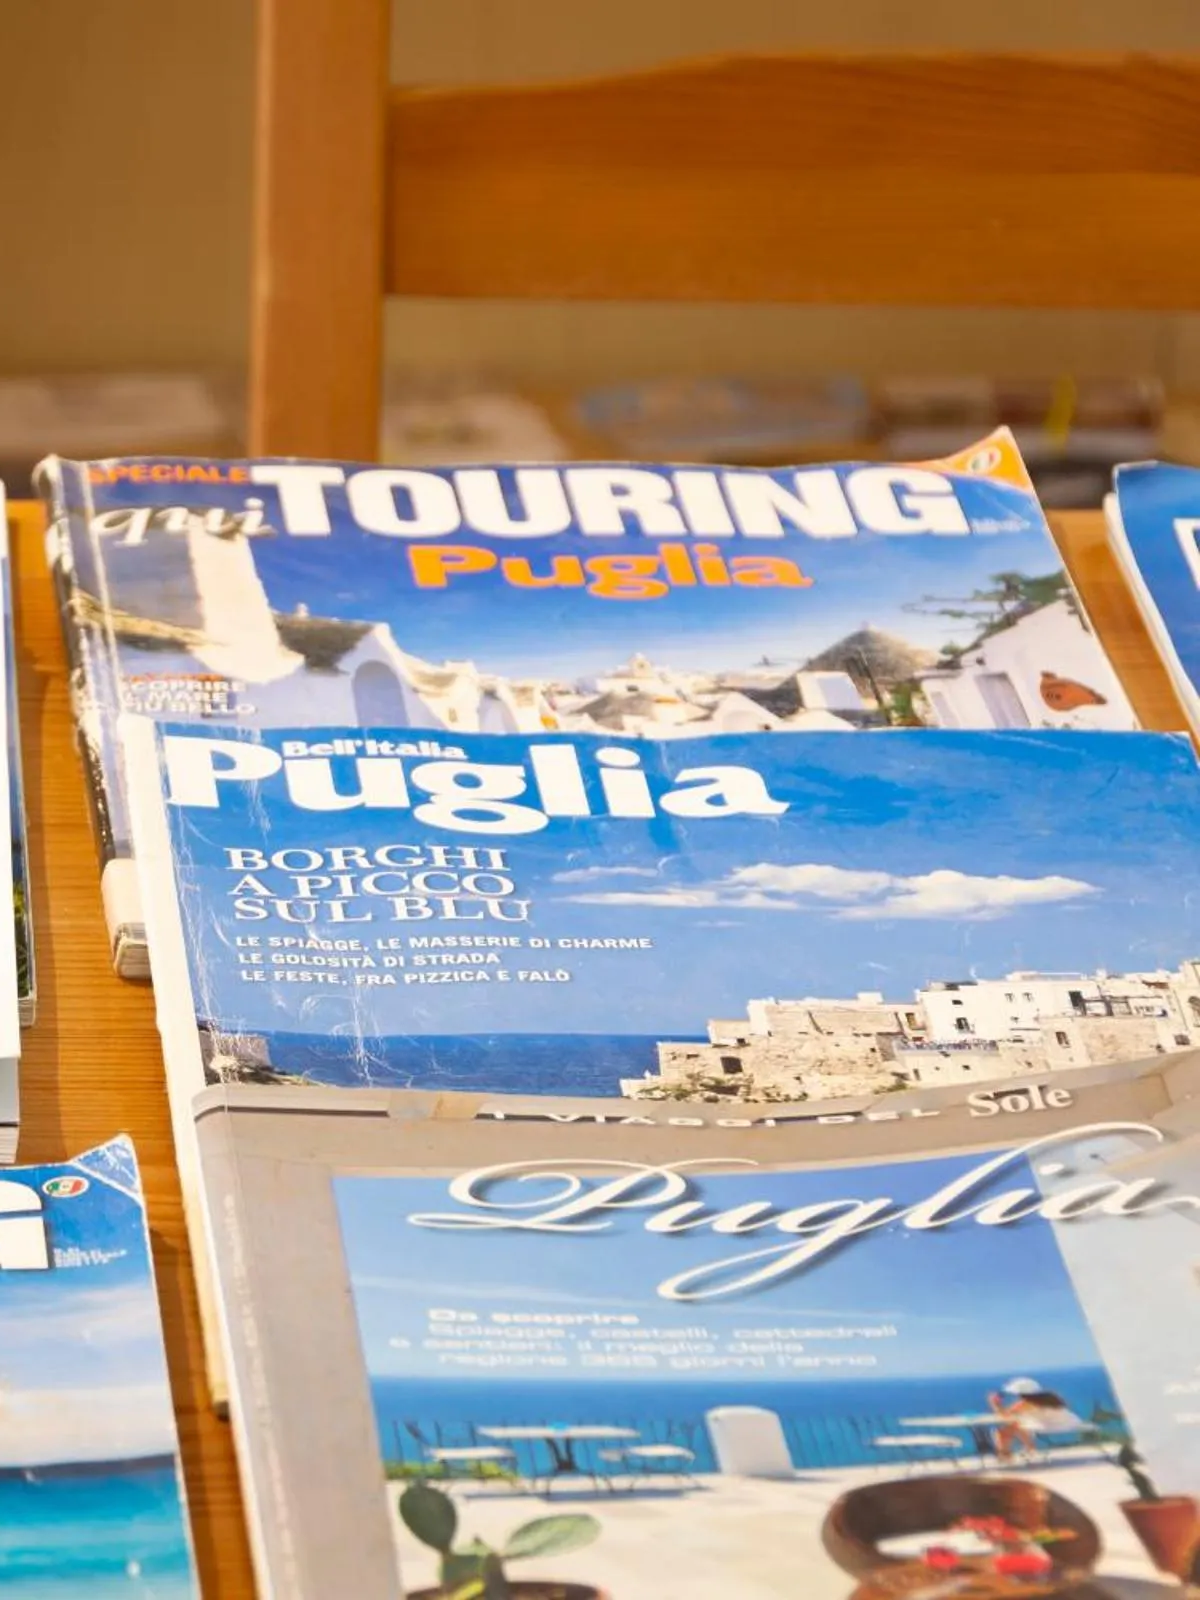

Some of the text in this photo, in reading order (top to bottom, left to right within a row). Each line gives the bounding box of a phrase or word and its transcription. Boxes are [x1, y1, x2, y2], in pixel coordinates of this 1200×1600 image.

[89, 464, 249, 484] SPECIALE
[93, 465, 971, 545] qui TOURING
[407, 543, 814, 599] Puglia
[282, 738, 468, 760] Bell'Italia
[163, 735, 791, 834] Puglia
[224, 845, 511, 872] BORGHI
[227, 871, 517, 899] A PICCO
[235, 897, 533, 923] SUL BLU
[236, 936, 653, 952] LE SPIAGGE, LE MASSERIE DI CHARME
[238, 952, 501, 968] LE GOLOSITÀ DI STRADA
[241, 968, 571, 986] LE FESTE, FRA PIZZICA E FALÒ
[967, 1083, 1074, 1118] Sole
[408, 1120, 1200, 1301] Puglia
[428, 1308, 640, 1326] Da scoprire
